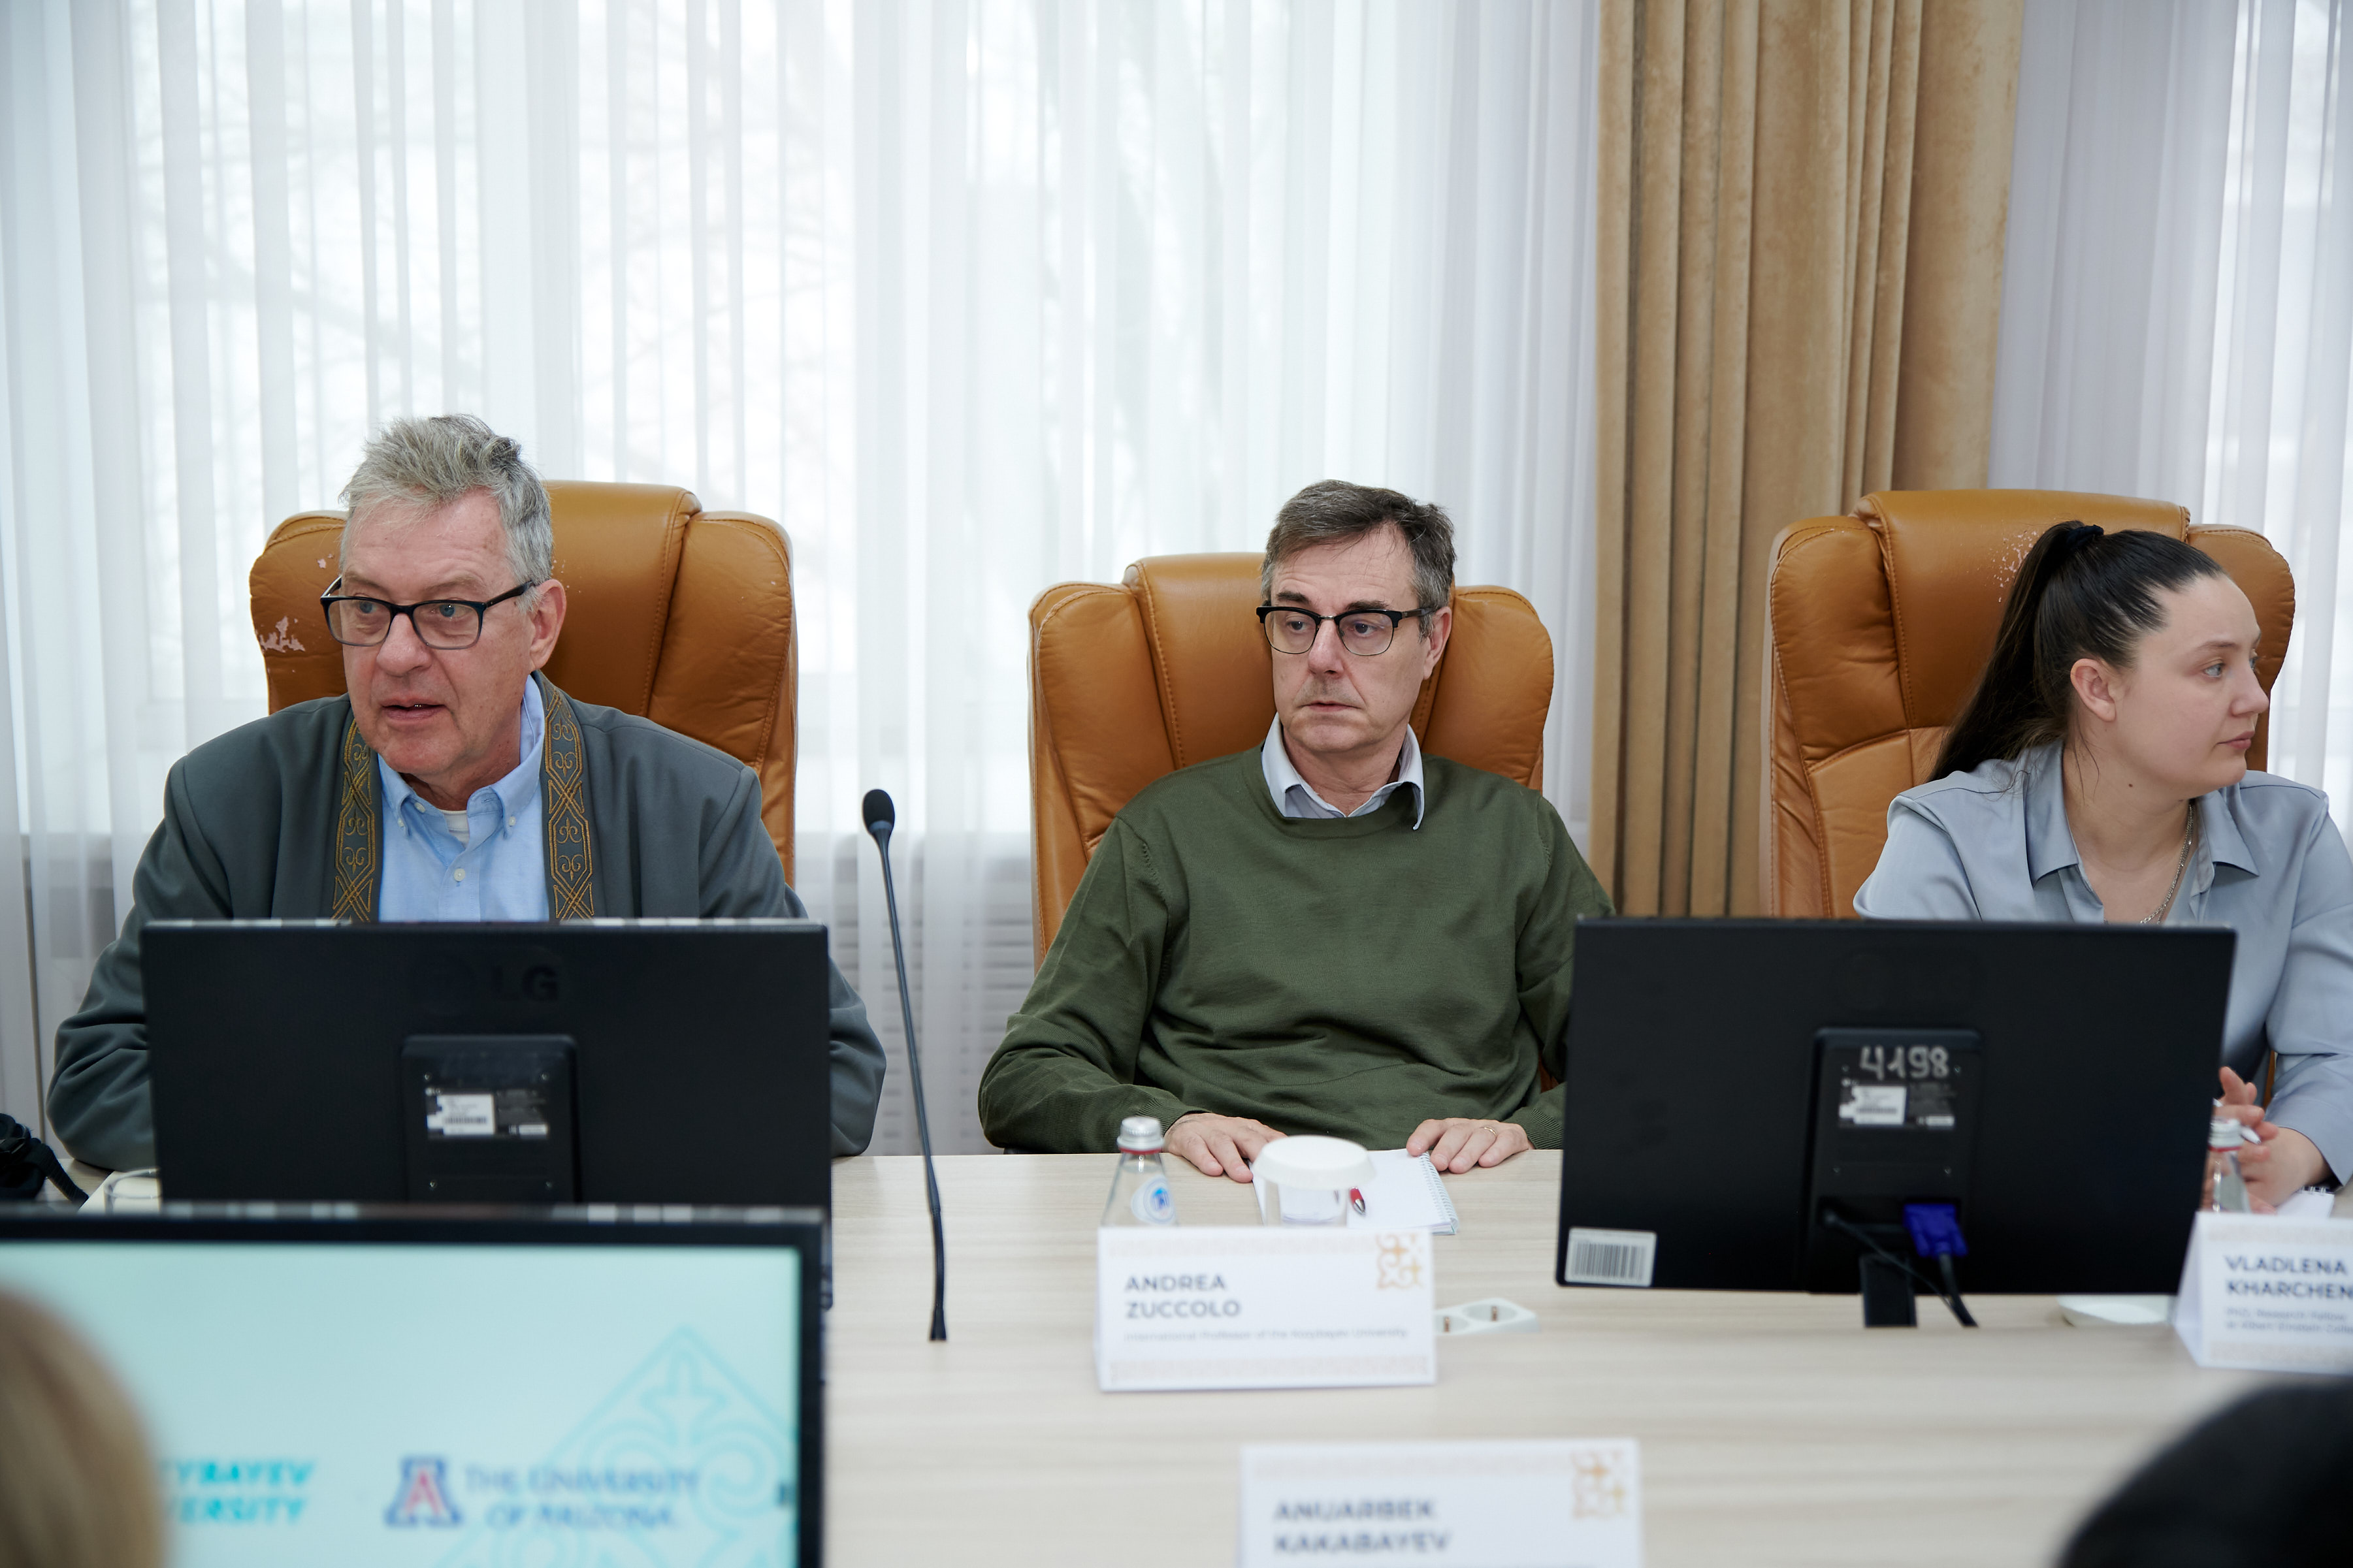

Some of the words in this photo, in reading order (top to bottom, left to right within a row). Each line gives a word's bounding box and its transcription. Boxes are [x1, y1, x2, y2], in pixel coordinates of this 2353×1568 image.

[491, 964, 558, 1002] LG
[1860, 1046, 1949, 1080] 4198
[2224, 1255, 2348, 1274] VLADLENA
[1124, 1274, 1227, 1292] ANDREA
[1126, 1300, 1242, 1319] ZUCCOLO
[1273, 1499, 1436, 1522] ANUARBEK
[1273, 1529, 1453, 1555] KAKABAYEV
